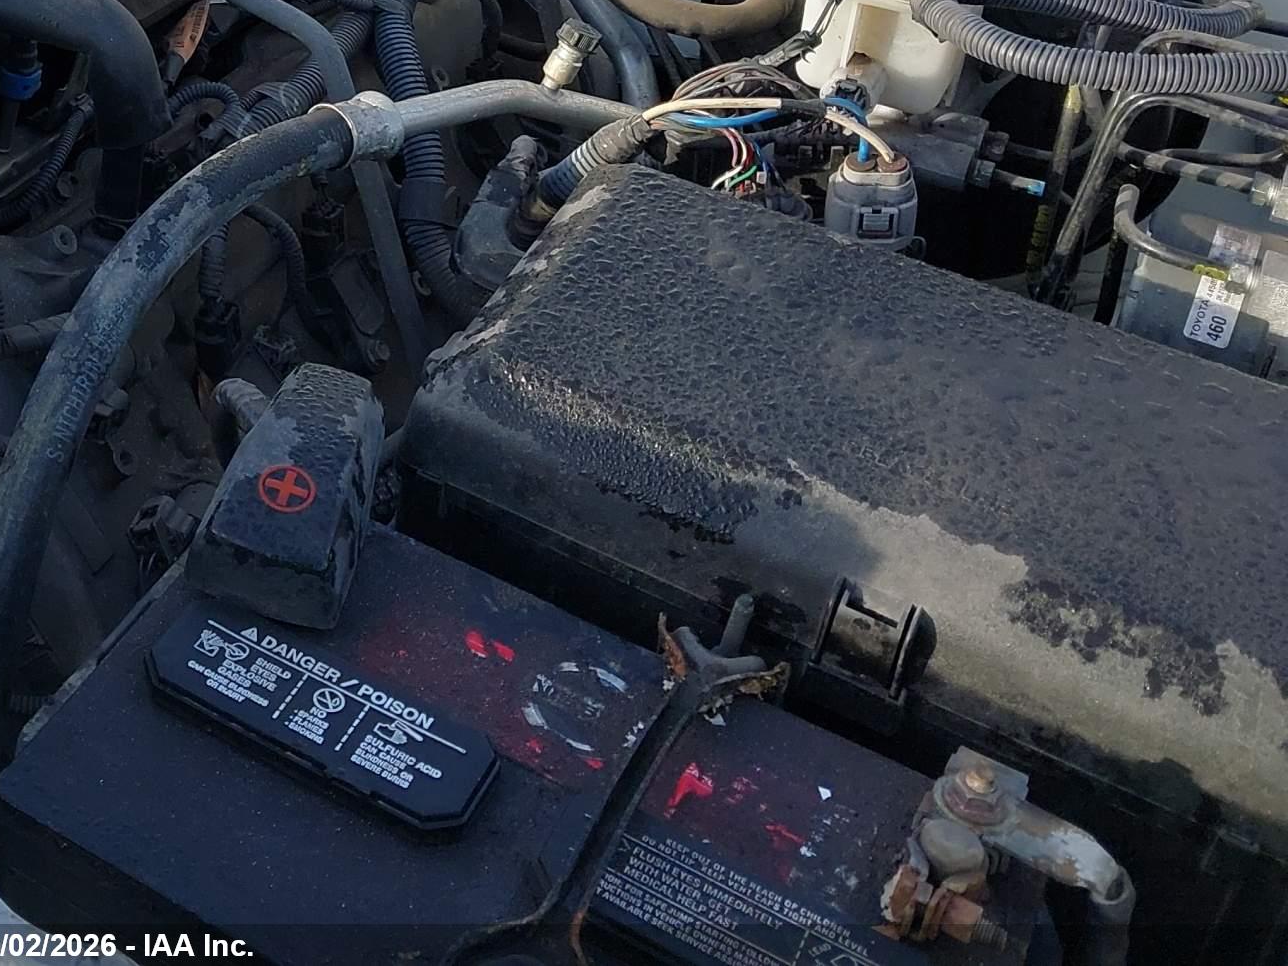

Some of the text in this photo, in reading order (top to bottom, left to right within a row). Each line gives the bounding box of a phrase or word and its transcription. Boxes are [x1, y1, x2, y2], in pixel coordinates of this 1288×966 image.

[1189, 300, 1210, 336] TOYOTA
[1207, 316, 1227, 341] 460
[187, 660, 270, 707] CAN CAUSE BLINDNESS
[206, 679, 220, 690] OR
[217, 666, 252, 688] GASES
[222, 659, 277, 692] EXPLOSIVE
[250, 664, 277, 682] EYES
[256, 657, 292, 680] SHIELD
[261, 635, 342, 683] DANGER
[357, 684, 434, 730] POISON
[309, 707, 328, 719] NO
[350, 755, 410, 789] SEVERE BURNS
[355, 748, 414, 783] BLINDNESS OR
[360, 743, 407, 770] CAN CAUSE
[364, 735, 443, 779] SULFURIC ACID
[623, 866, 739, 931] MEDICAL HELP FAST
[628, 856, 659, 878] WITH
[708, 899, 732, 916] GET
[632, 846, 784, 931] FLUSH EYES IMMEDIATELY
[660, 844, 679, 857] NOT
[701, 865, 727, 882] KEEP
[727, 879, 752, 897] VENT
[755, 893, 780, 911] CAPS
[783, 908, 812, 926] TIGHT
[814, 924, 836, 940] AND
[838, 935, 869, 957] LEVEL
[666, 838, 852, 938] KEEP OUT OF THE REACH OF CHILDREN
[598, 880, 641, 908] RUCTIONS
[642, 902, 654, 914] IN
[655, 907, 691, 934] VEHICLE
[601, 890, 650, 922] AVAILABLE
[650, 916, 674, 934] SEEK
[674, 929, 713, 955] SERVICE
[624, 883, 643, 898] FOR
[644, 892, 668, 912] SAFE
[666, 904, 695, 925] JUMP
[694, 921, 740, 949] STARTING
